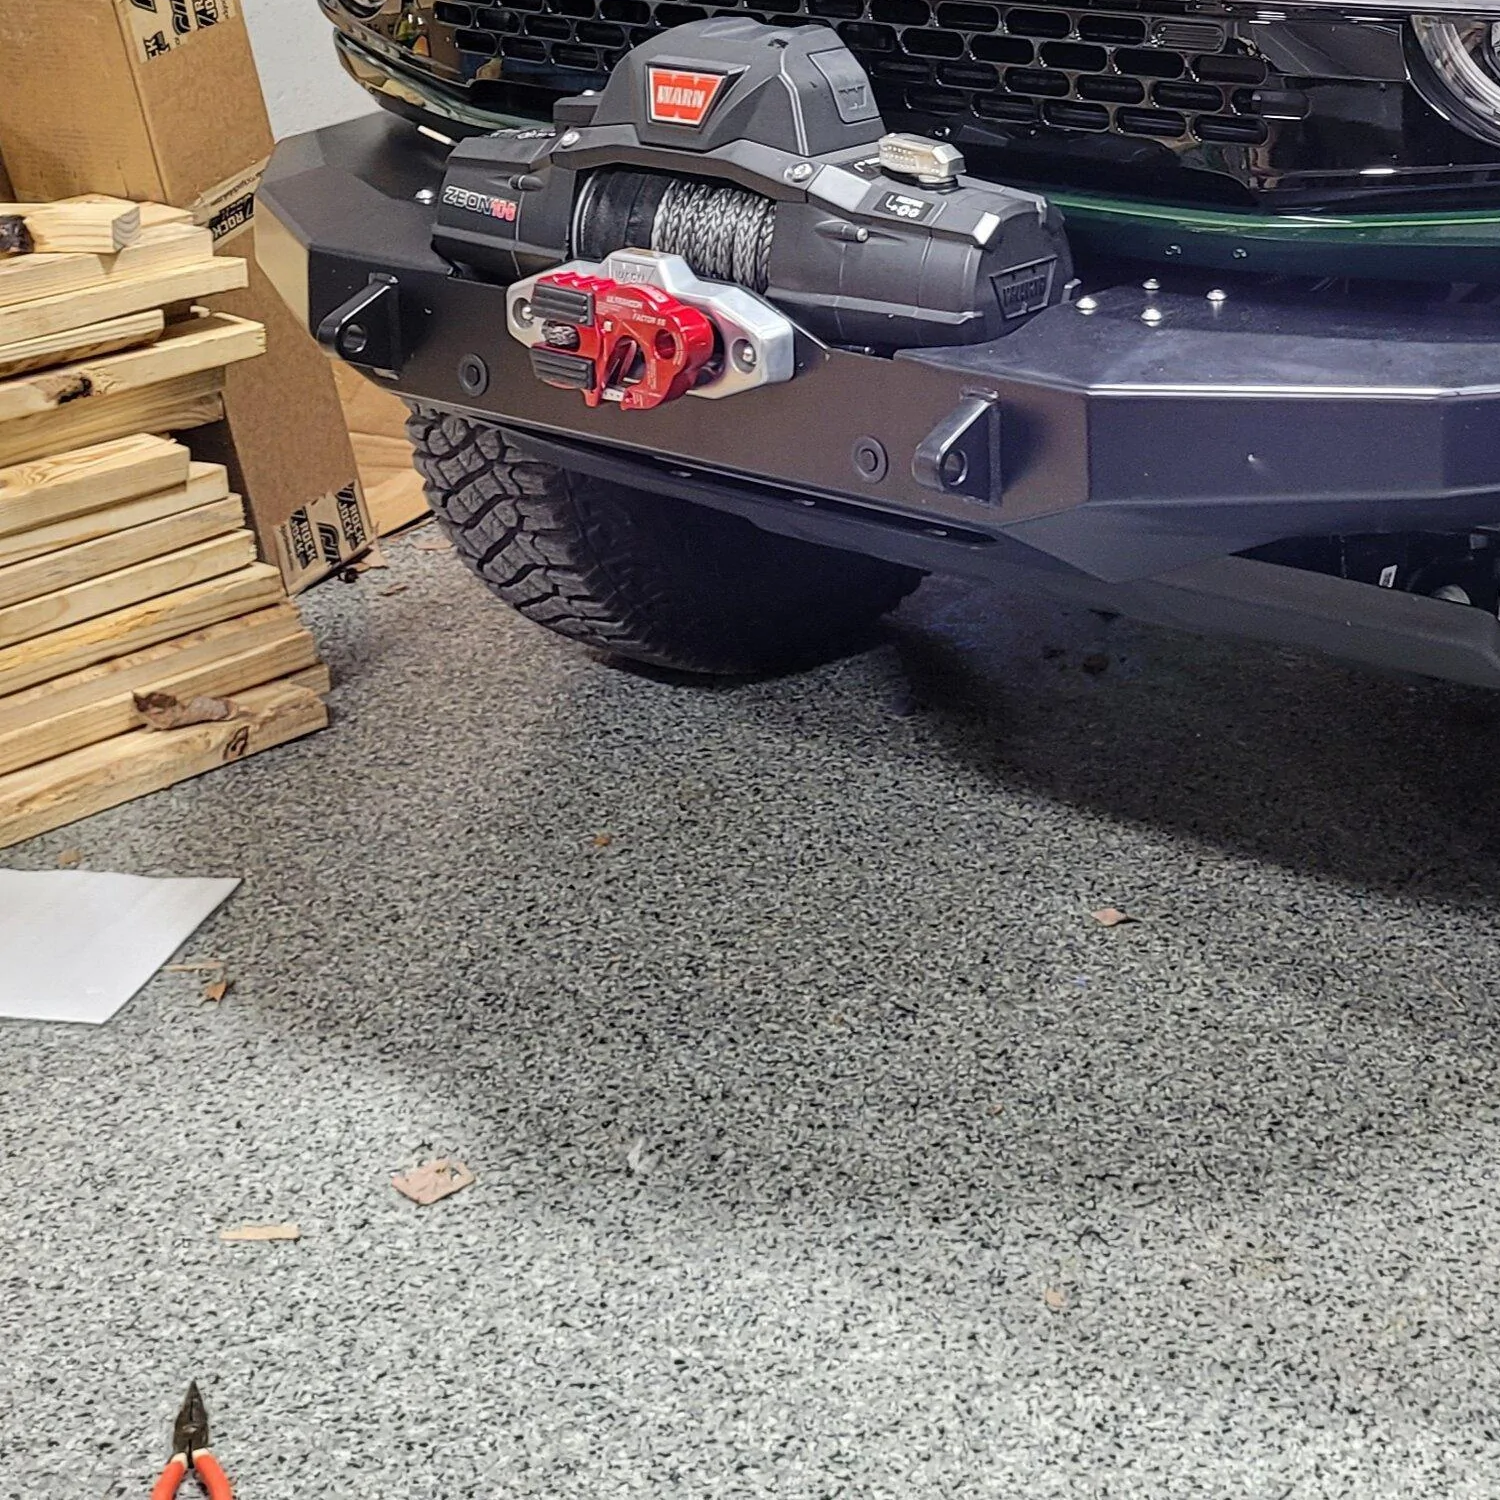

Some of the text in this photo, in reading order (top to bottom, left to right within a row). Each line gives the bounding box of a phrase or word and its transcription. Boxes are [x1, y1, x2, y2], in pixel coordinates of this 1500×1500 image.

[656, 84, 707, 108] WARN
[338, 501, 353, 539] JOCK
[349, 503, 365, 543] ROCK
[300, 520, 317, 561] ROCK
